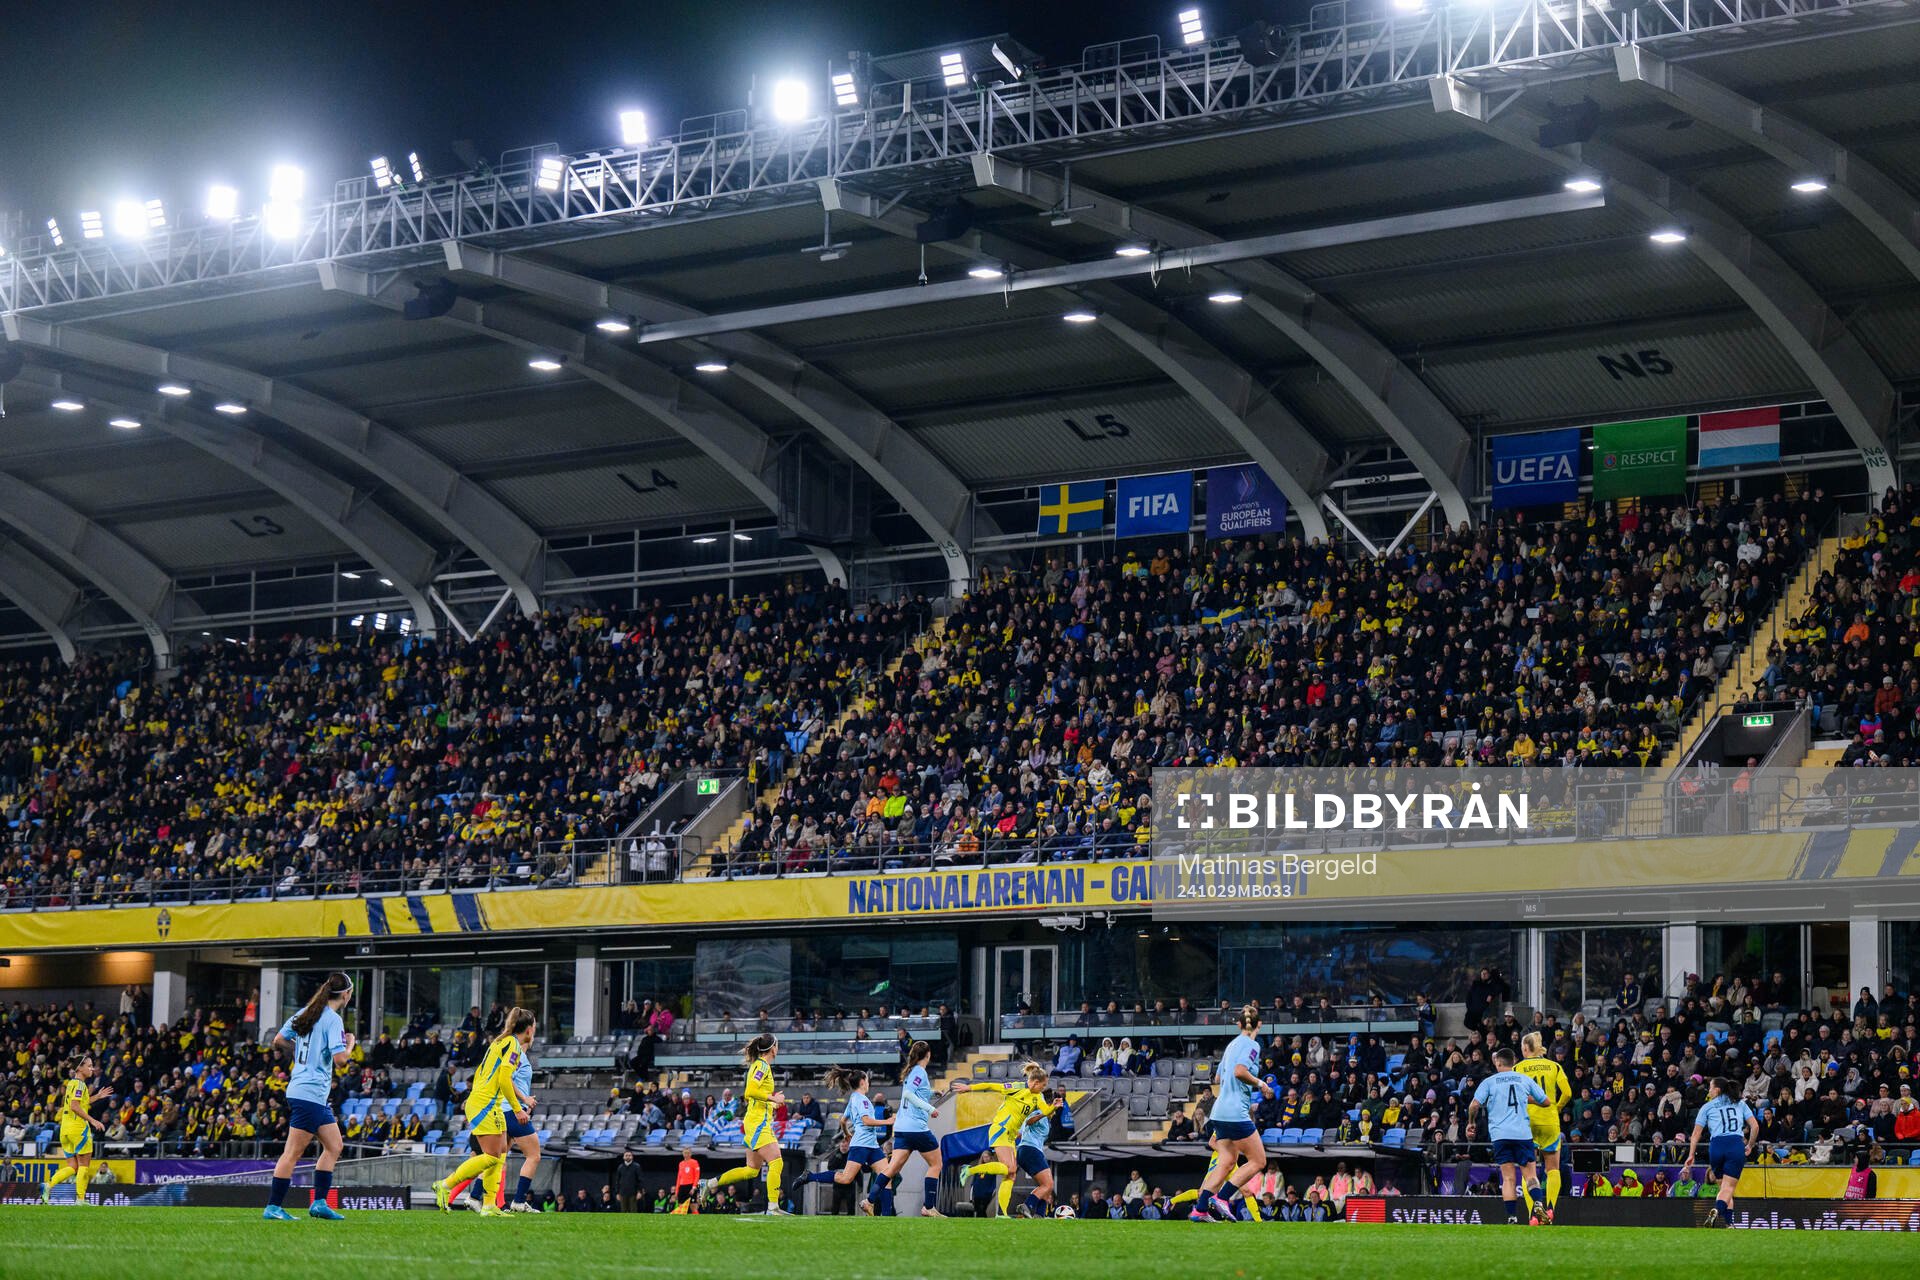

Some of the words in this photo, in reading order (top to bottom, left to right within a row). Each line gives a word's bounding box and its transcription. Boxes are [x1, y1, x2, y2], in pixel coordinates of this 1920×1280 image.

[1597, 350, 1674, 381] N5
[1063, 414, 1129, 441] L5
[1497, 455, 1574, 484] UEFA
[1621, 450, 1677, 466] RESPECT
[617, 469, 678, 494] L4
[1129, 493, 1179, 518] FIFA
[1221, 508, 1271, 522] EUROPEAN
[230, 515, 284, 537] L3
[1220, 517, 1272, 531] QUALIFIERS
[1698, 760, 1720, 787] N5
[848, 867, 1085, 914] NATIONALARENAN
[1021, 1105, 1031, 1115] 18
[1508, 1084, 1519, 1114] 4
[1719, 1107, 1738, 1133] 16
[341, 1196, 405, 1210] SVENSKA
[1392, 1208, 1482, 1225] SVENSKA
